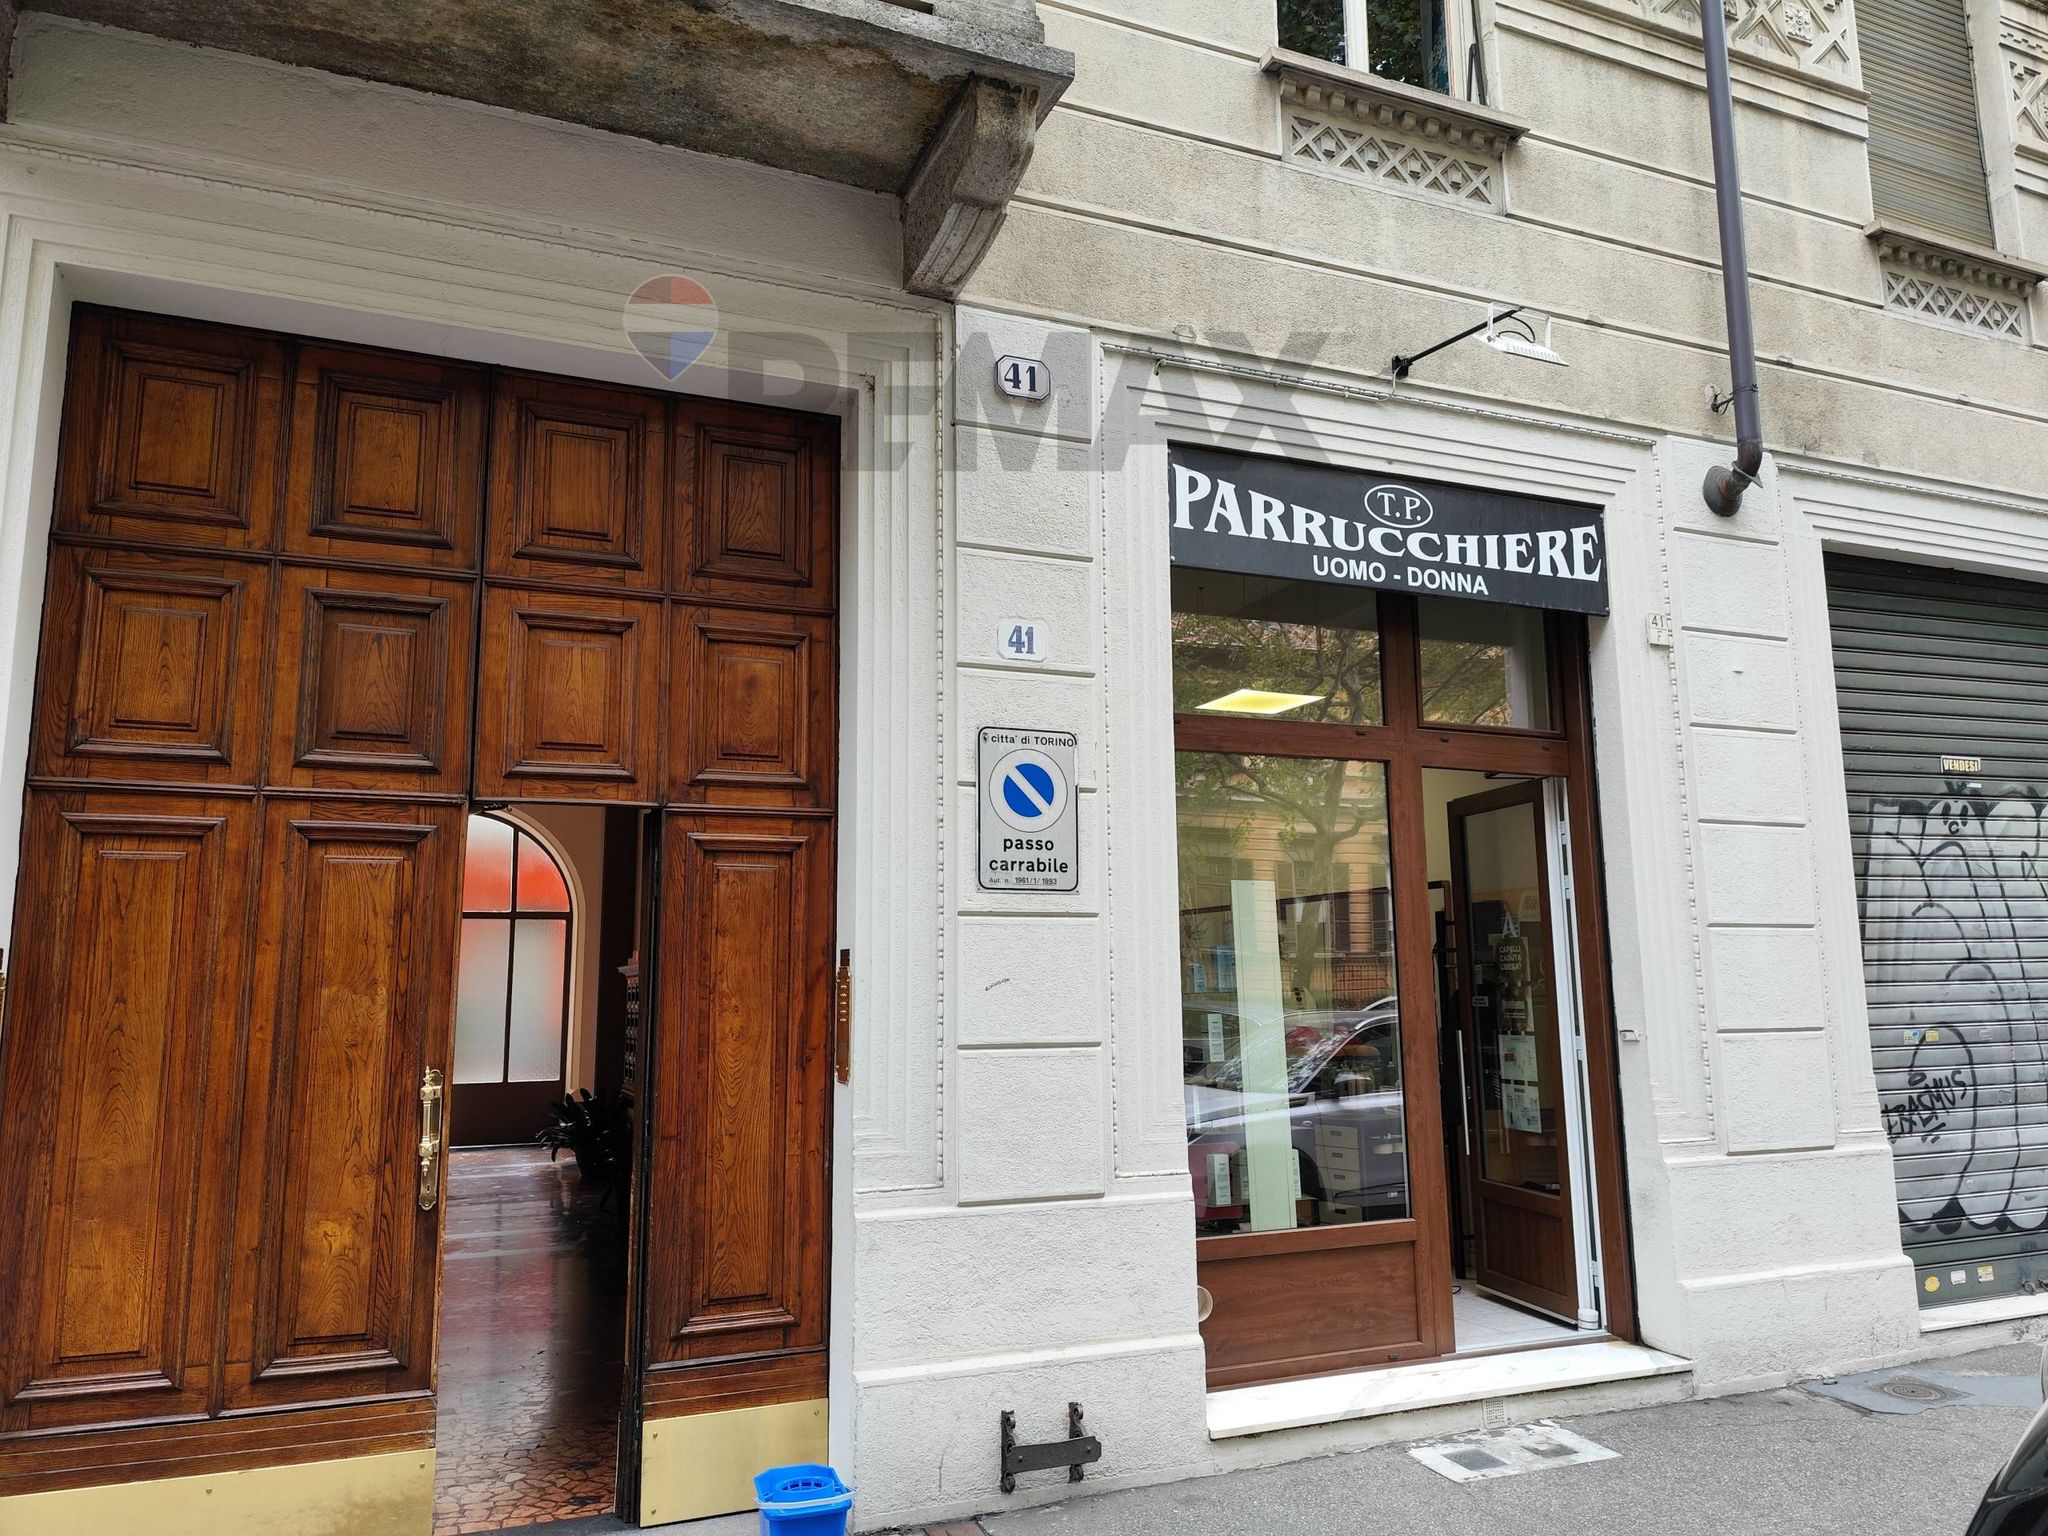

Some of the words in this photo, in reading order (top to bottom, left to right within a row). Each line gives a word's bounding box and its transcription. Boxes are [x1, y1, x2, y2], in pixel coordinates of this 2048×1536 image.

[1003, 362, 1038, 393] 41
[1377, 491, 1422, 522] T.P.
[1171, 463, 1602, 583] PARRUCCHIERE
[1312, 554, 1387, 583] UOMO
[1406, 565, 1489, 596] DONNA
[1007, 625, 1036, 655] 41
[1020, 735, 1030, 745] di
[1034, 736, 1074, 748] TORINO
[1943, 758, 1978, 772] VENDESI
[1003, 838, 1055, 852] passo
[989, 857, 1069, 873] carrabile
